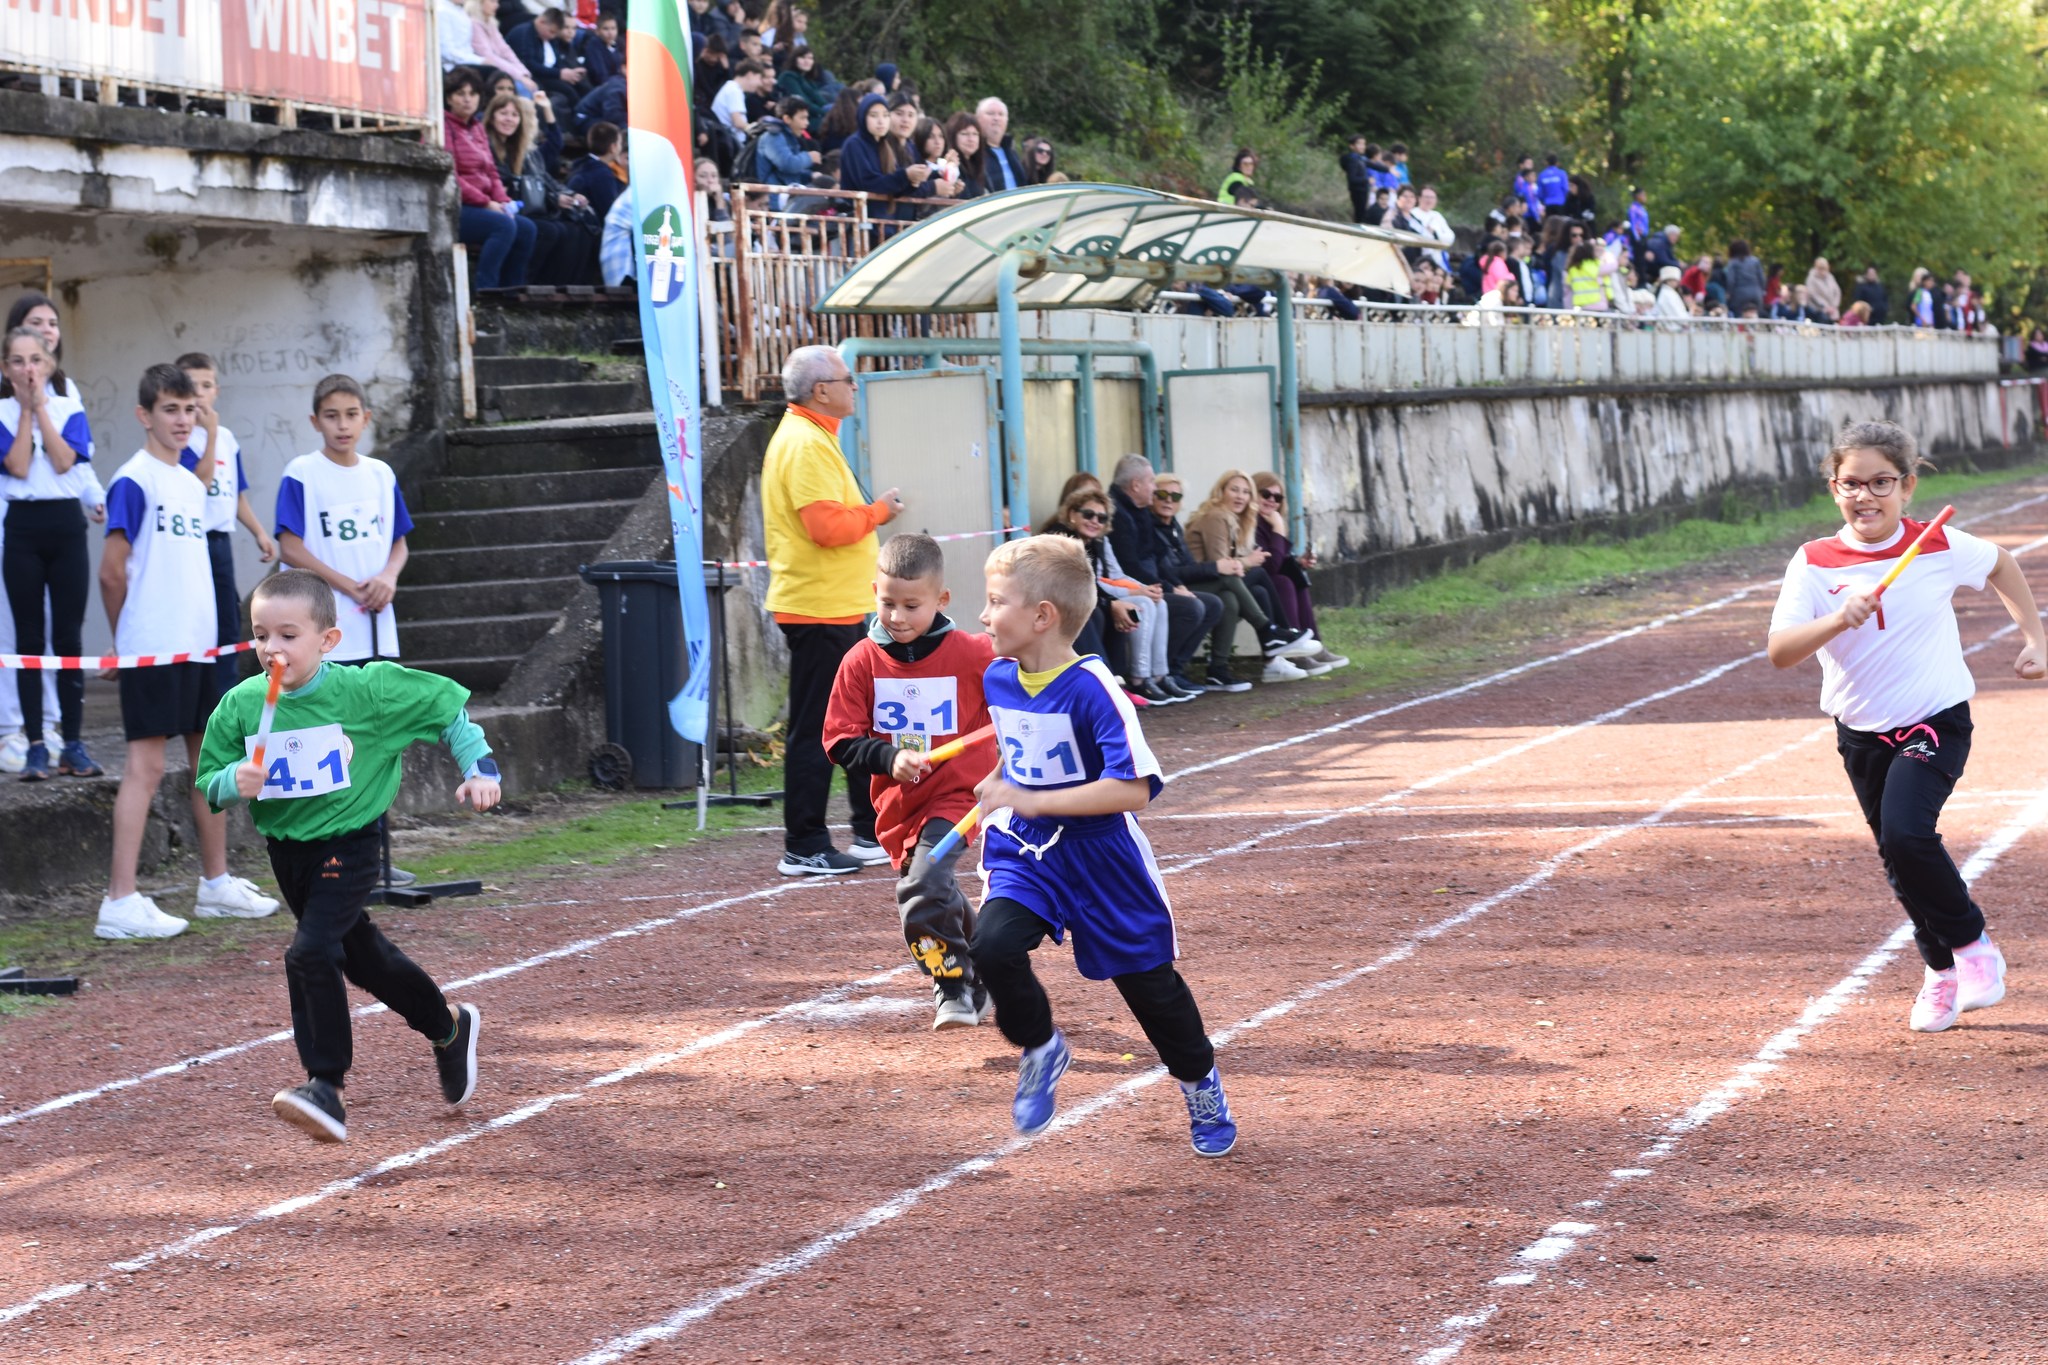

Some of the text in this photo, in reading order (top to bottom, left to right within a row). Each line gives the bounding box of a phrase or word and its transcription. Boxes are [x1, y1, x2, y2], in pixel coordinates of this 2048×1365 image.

[245, 0, 406, 73] WINBET
[877, 699, 953, 732] 3.1
[264, 748, 345, 792] 4.1
[1004, 736, 1079, 779] 2.1
